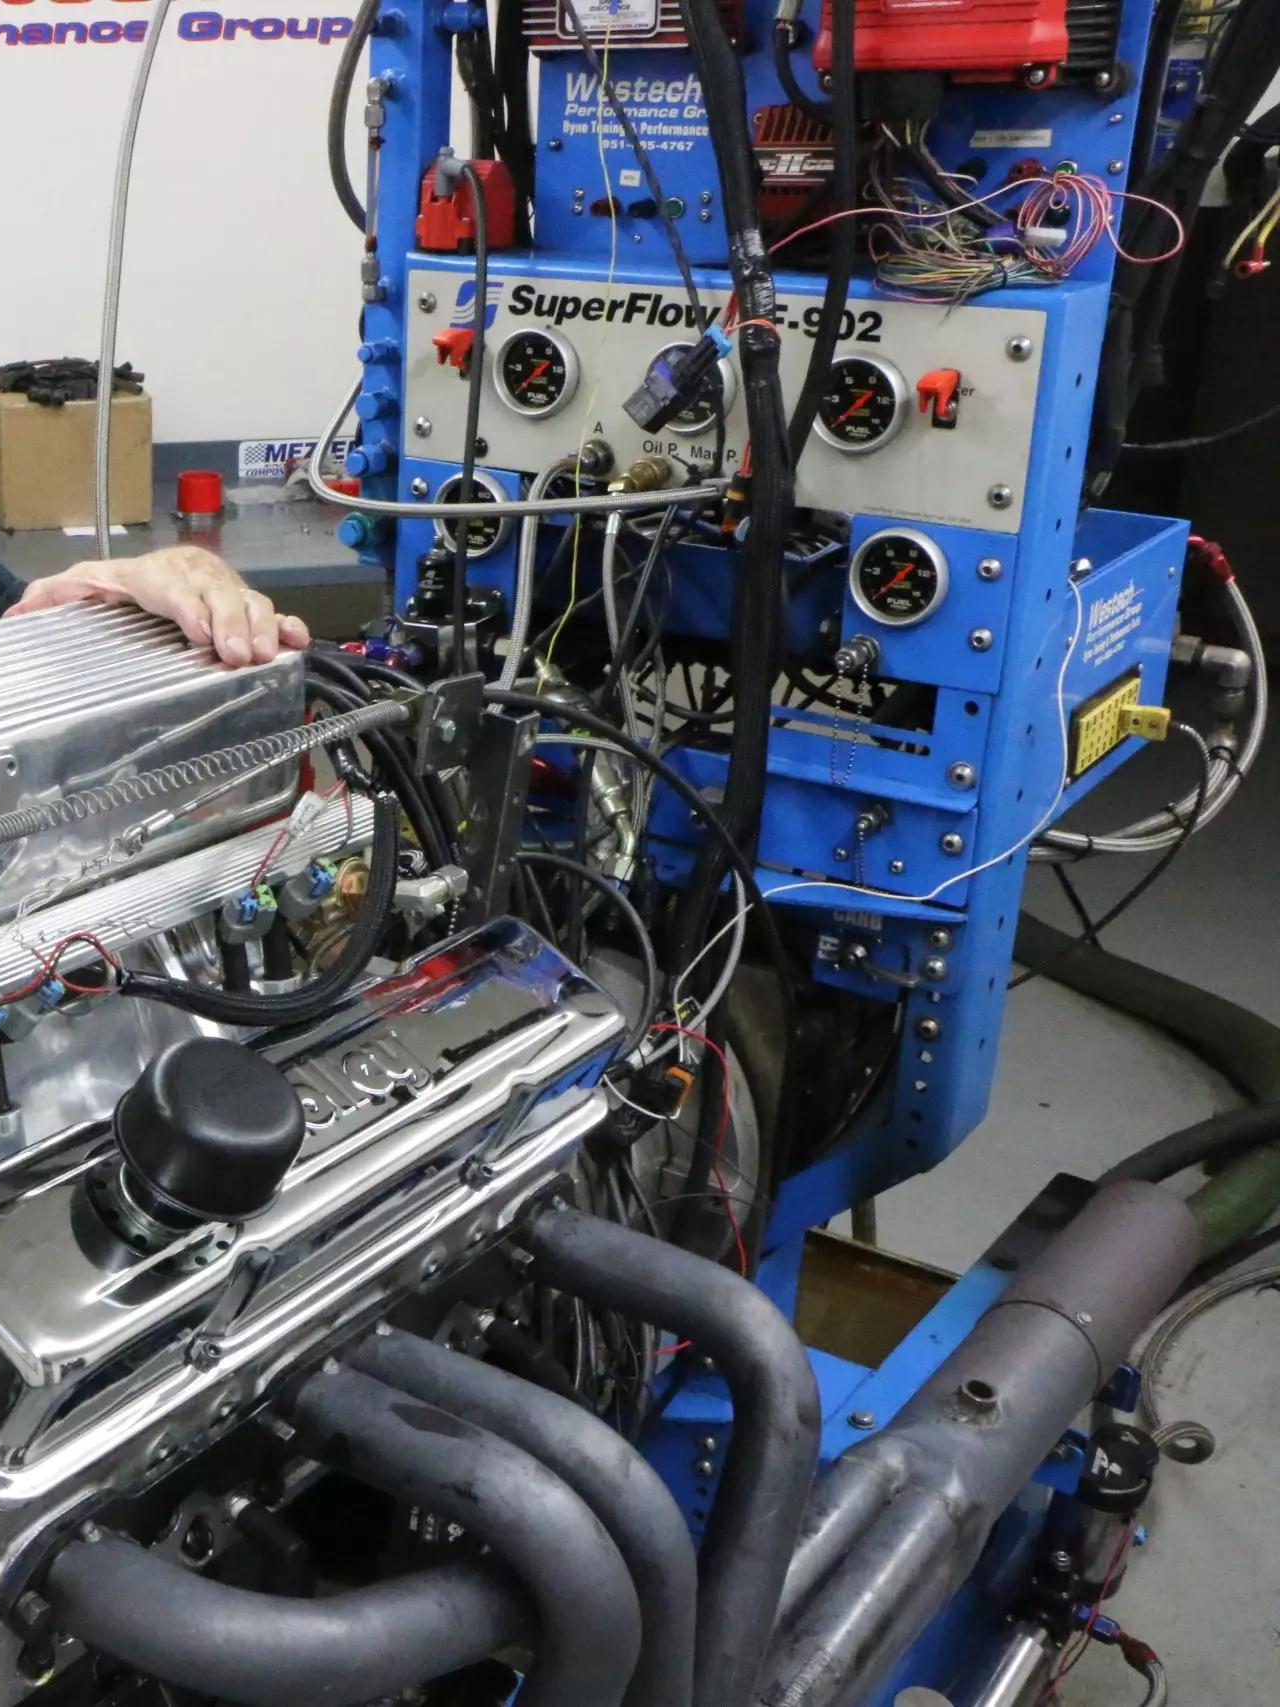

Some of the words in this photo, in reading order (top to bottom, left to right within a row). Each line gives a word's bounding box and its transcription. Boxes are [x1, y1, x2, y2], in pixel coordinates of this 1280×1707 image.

[177, 11, 355, 45] Group
[566, 72, 704, 103] Westech
[683, 105, 708, 118] Gr
[563, 120, 589, 136] Dyno
[640, 121, 710, 137] Performance
[602, 139, 694, 151] 951-5-4767
[508, 284, 722, 328] SuperFlow
[593, 421, 604, 434] A
[642, 440, 663, 454] Oil
[667, 442, 679, 456] P.
[726, 449, 739, 463] P.
